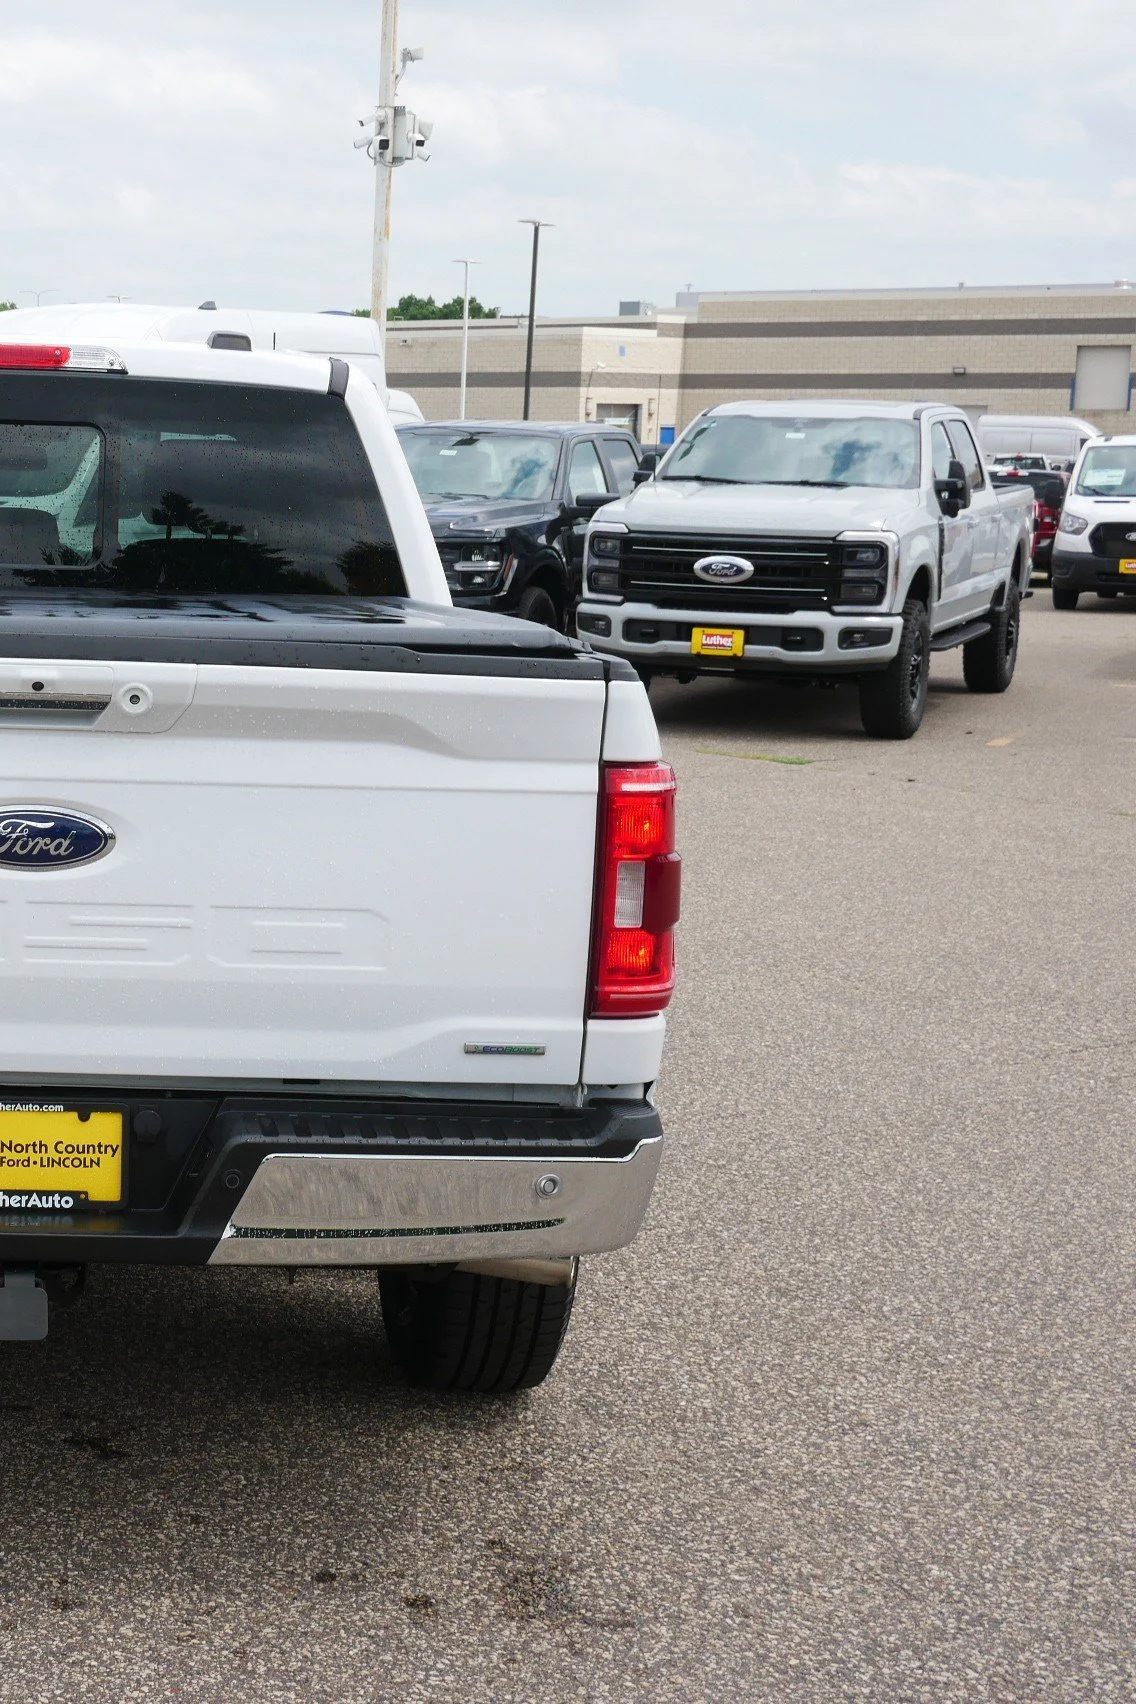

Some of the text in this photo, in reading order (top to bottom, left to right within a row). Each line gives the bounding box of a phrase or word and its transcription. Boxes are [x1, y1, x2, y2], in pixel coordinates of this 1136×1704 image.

[709, 563, 737, 576] Ford
[702, 634, 733, 647] Luther
[0, 1140, 120, 1157] North Country
